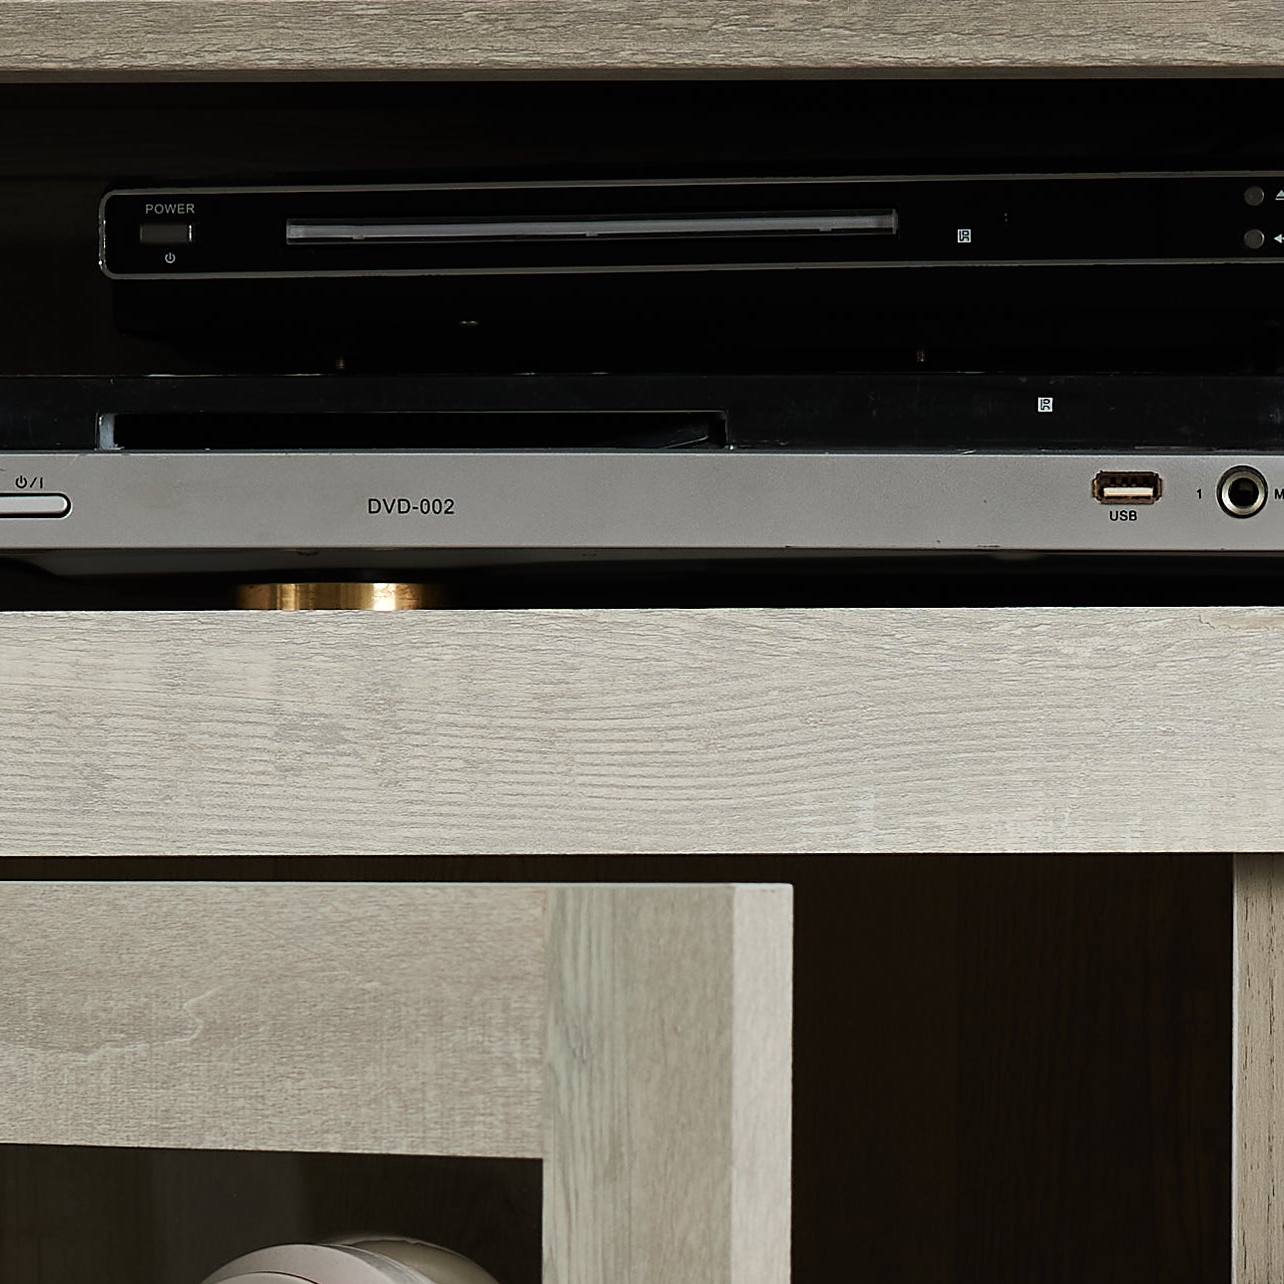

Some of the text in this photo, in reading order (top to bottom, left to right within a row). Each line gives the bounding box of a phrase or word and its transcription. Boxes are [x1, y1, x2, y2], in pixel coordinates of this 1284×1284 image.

[145, 203, 195, 215] POWER
[1196, 488, 1203, 500] 1
[367, 498, 455, 515] DVD-002
[1109, 509, 1138, 522] USB
